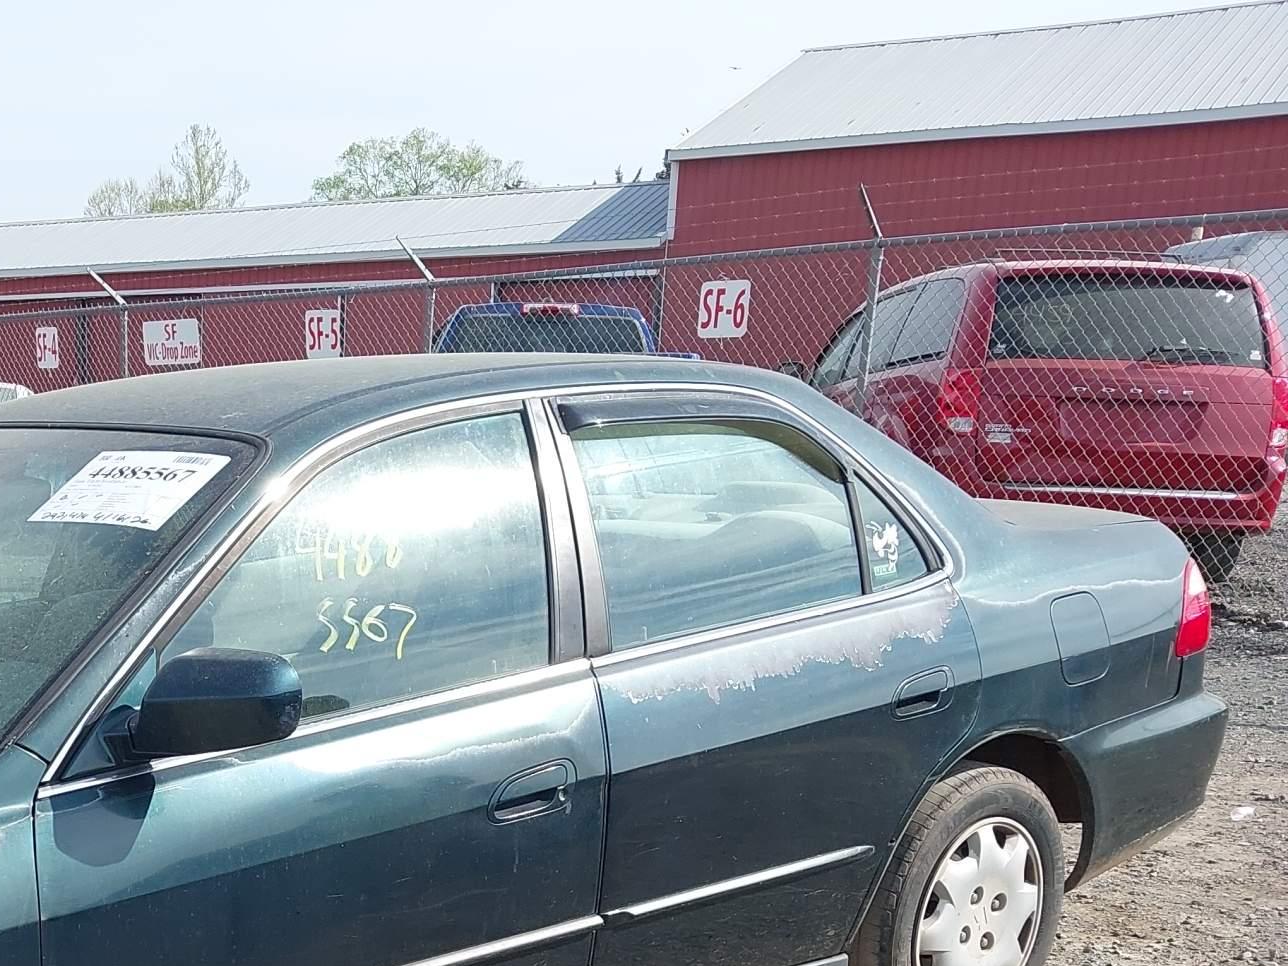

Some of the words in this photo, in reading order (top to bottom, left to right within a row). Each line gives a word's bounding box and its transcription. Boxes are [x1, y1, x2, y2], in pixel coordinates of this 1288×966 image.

[700, 287, 746, 329] SF-6
[37, 332, 58, 362] SF-4
[164, 323, 178, 342] SF
[308, 316, 339, 351] SF-5
[180, 341, 199, 360] Zone
[88, 465, 199, 484] 44885567
[317, 596, 418, 661] 5567
